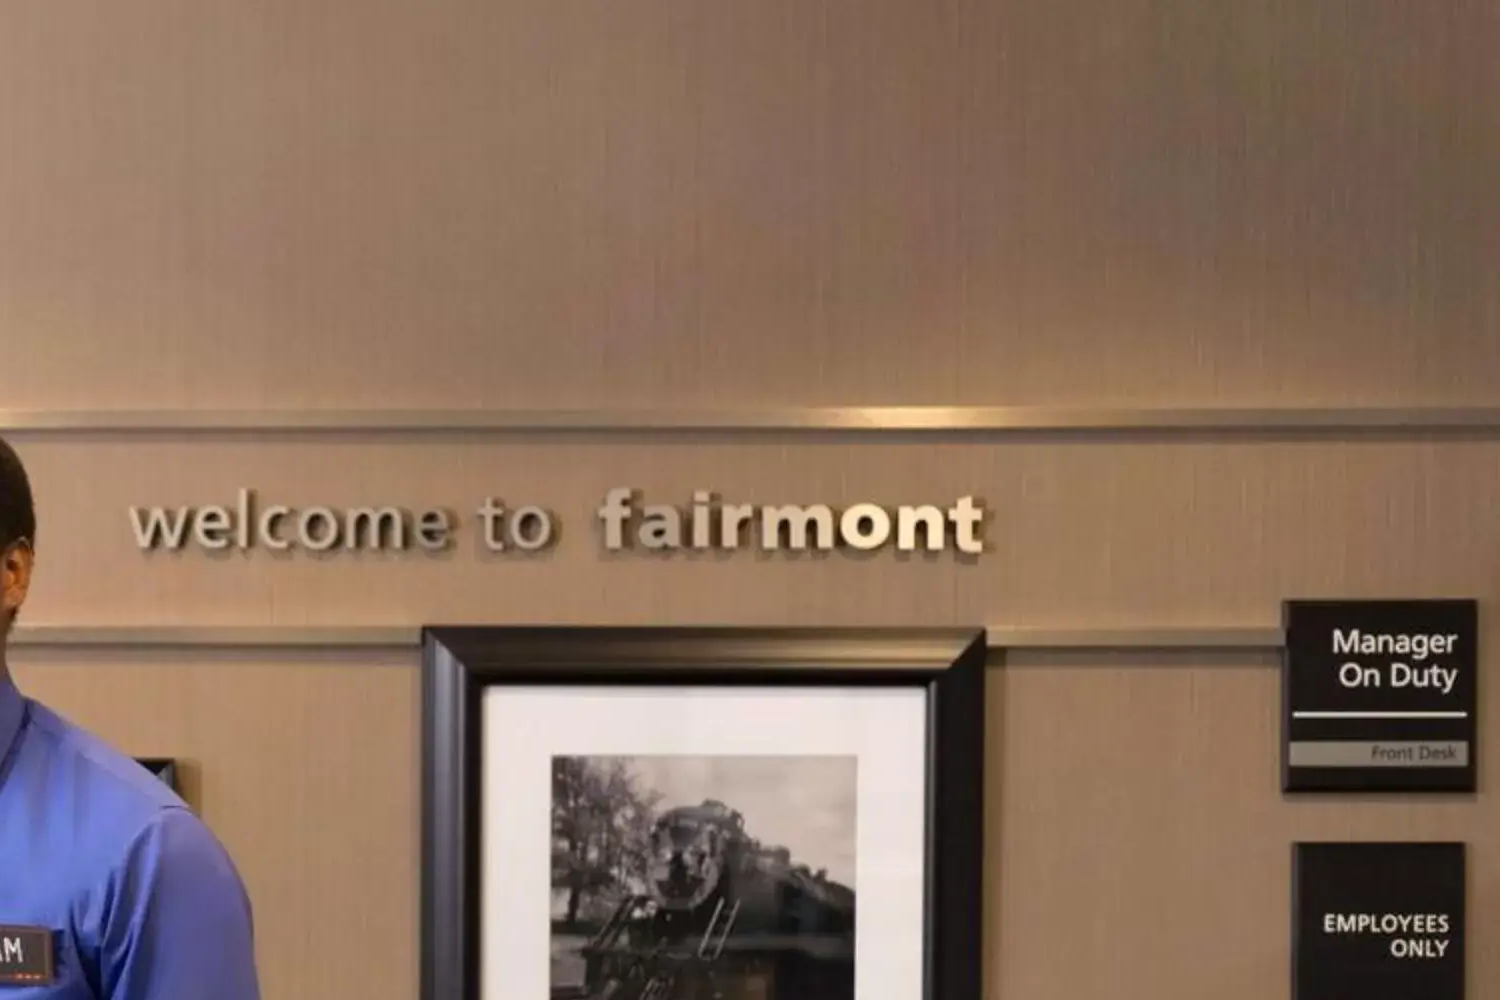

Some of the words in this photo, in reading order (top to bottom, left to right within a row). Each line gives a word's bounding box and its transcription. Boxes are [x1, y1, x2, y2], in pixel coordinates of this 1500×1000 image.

[128, 487, 448, 550] welcome
[476, 496, 552, 551] to
[598, 487, 984, 553] fairmont
[1332, 628, 1458, 660] Manager
[1338, 662, 1381, 688] On
[1390, 662, 1458, 694] Duty
[1371, 745, 1414, 761] Front
[1418, 745, 1458, 761] Desk
[1323, 913, 1450, 934] EMPLOYEES
[1389, 938, 1450, 958] ONLY
